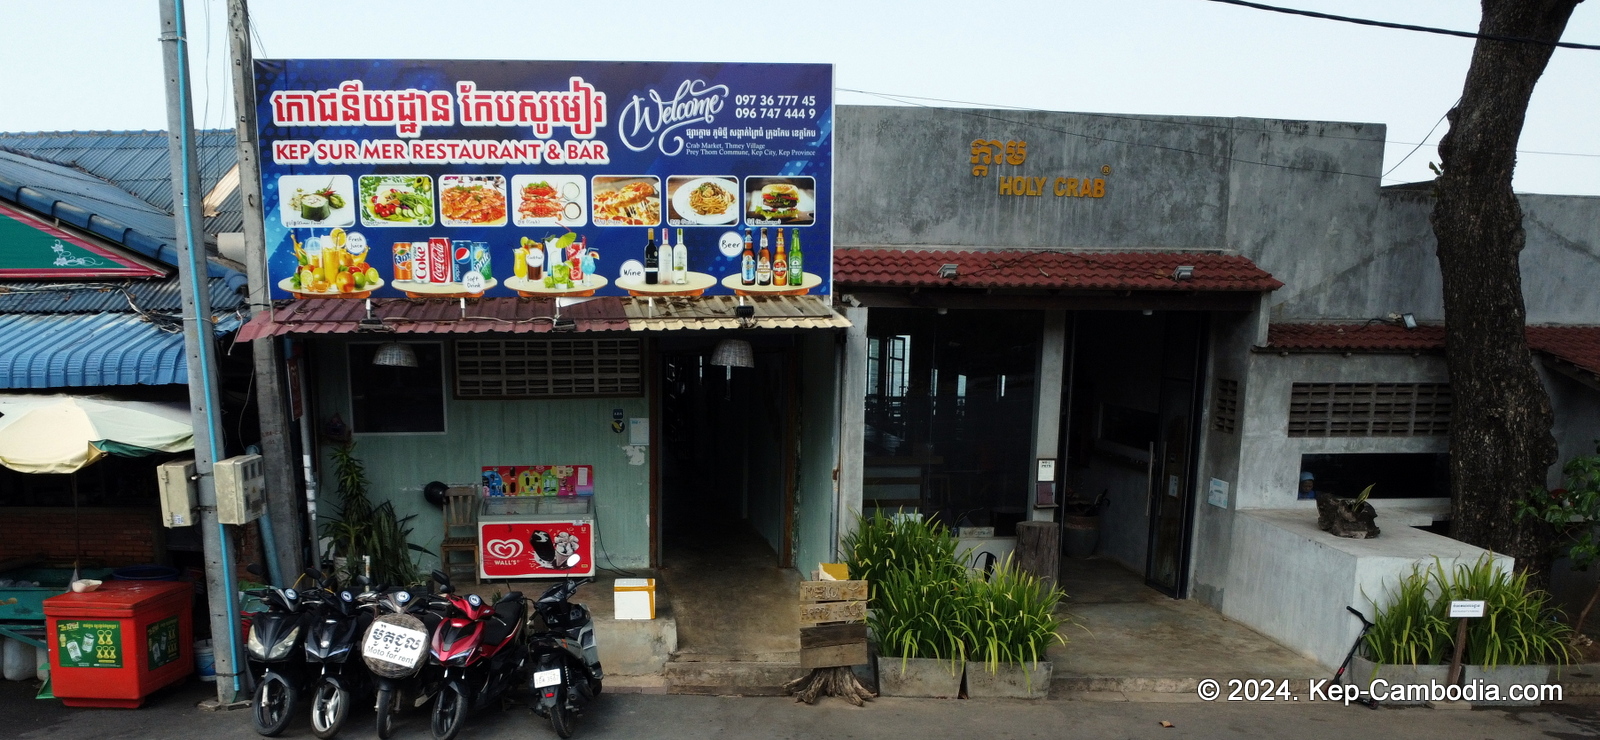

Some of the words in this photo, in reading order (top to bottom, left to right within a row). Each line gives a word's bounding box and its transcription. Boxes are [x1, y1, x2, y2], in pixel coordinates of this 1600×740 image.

[735, 95, 756, 106] 097
[760, 95, 774, 106] 36
[777, 95, 798, 106] 777
[801, 95, 816, 106] 45
[619, 79, 729, 156] Welcome
[735, 108, 756, 119] 096
[760, 108, 780, 119] 747
[784, 108, 806, 119] 444
[808, 108, 816, 119] 9
[276, 144, 311, 160] KEP
[317, 144, 356, 160] SUR
[363, 144, 405, 160] MER
[413, 144, 542, 160] RESTAURANT
[547, 144, 561, 160] &
[567, 144, 606, 160] BAR
[746, 142, 766, 150] Village
[999, 176, 1047, 196] HOLY
[1053, 176, 1106, 198] CRAB
[721, 240, 740, 249] Beer
[414, 246, 427, 280] Coke
[623, 268, 641, 276] Wine
[366, 645, 385, 657] Moto
[386, 651, 398, 659] for
[397, 655, 414, 665] rent
